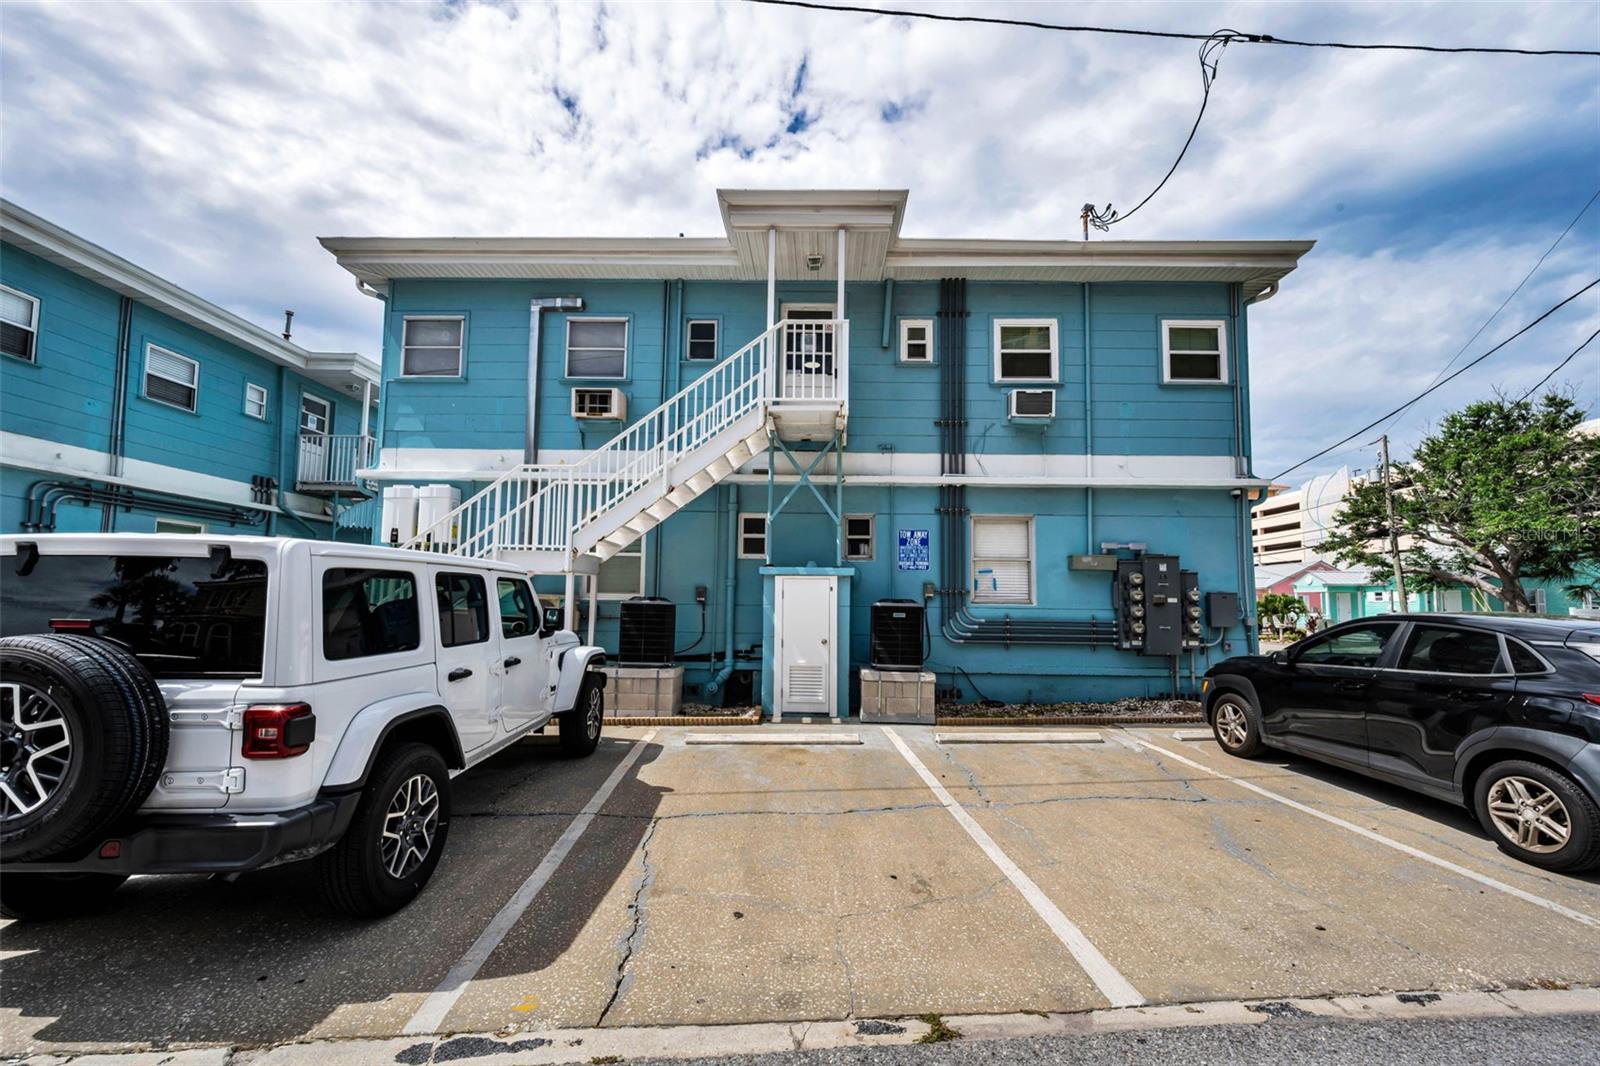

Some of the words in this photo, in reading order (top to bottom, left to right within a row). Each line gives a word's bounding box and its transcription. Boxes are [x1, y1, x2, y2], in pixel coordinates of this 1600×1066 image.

[900, 530, 911, 539] TOW
[913, 530, 928, 539] AWAY
[906, 538, 921, 546] ZONE
